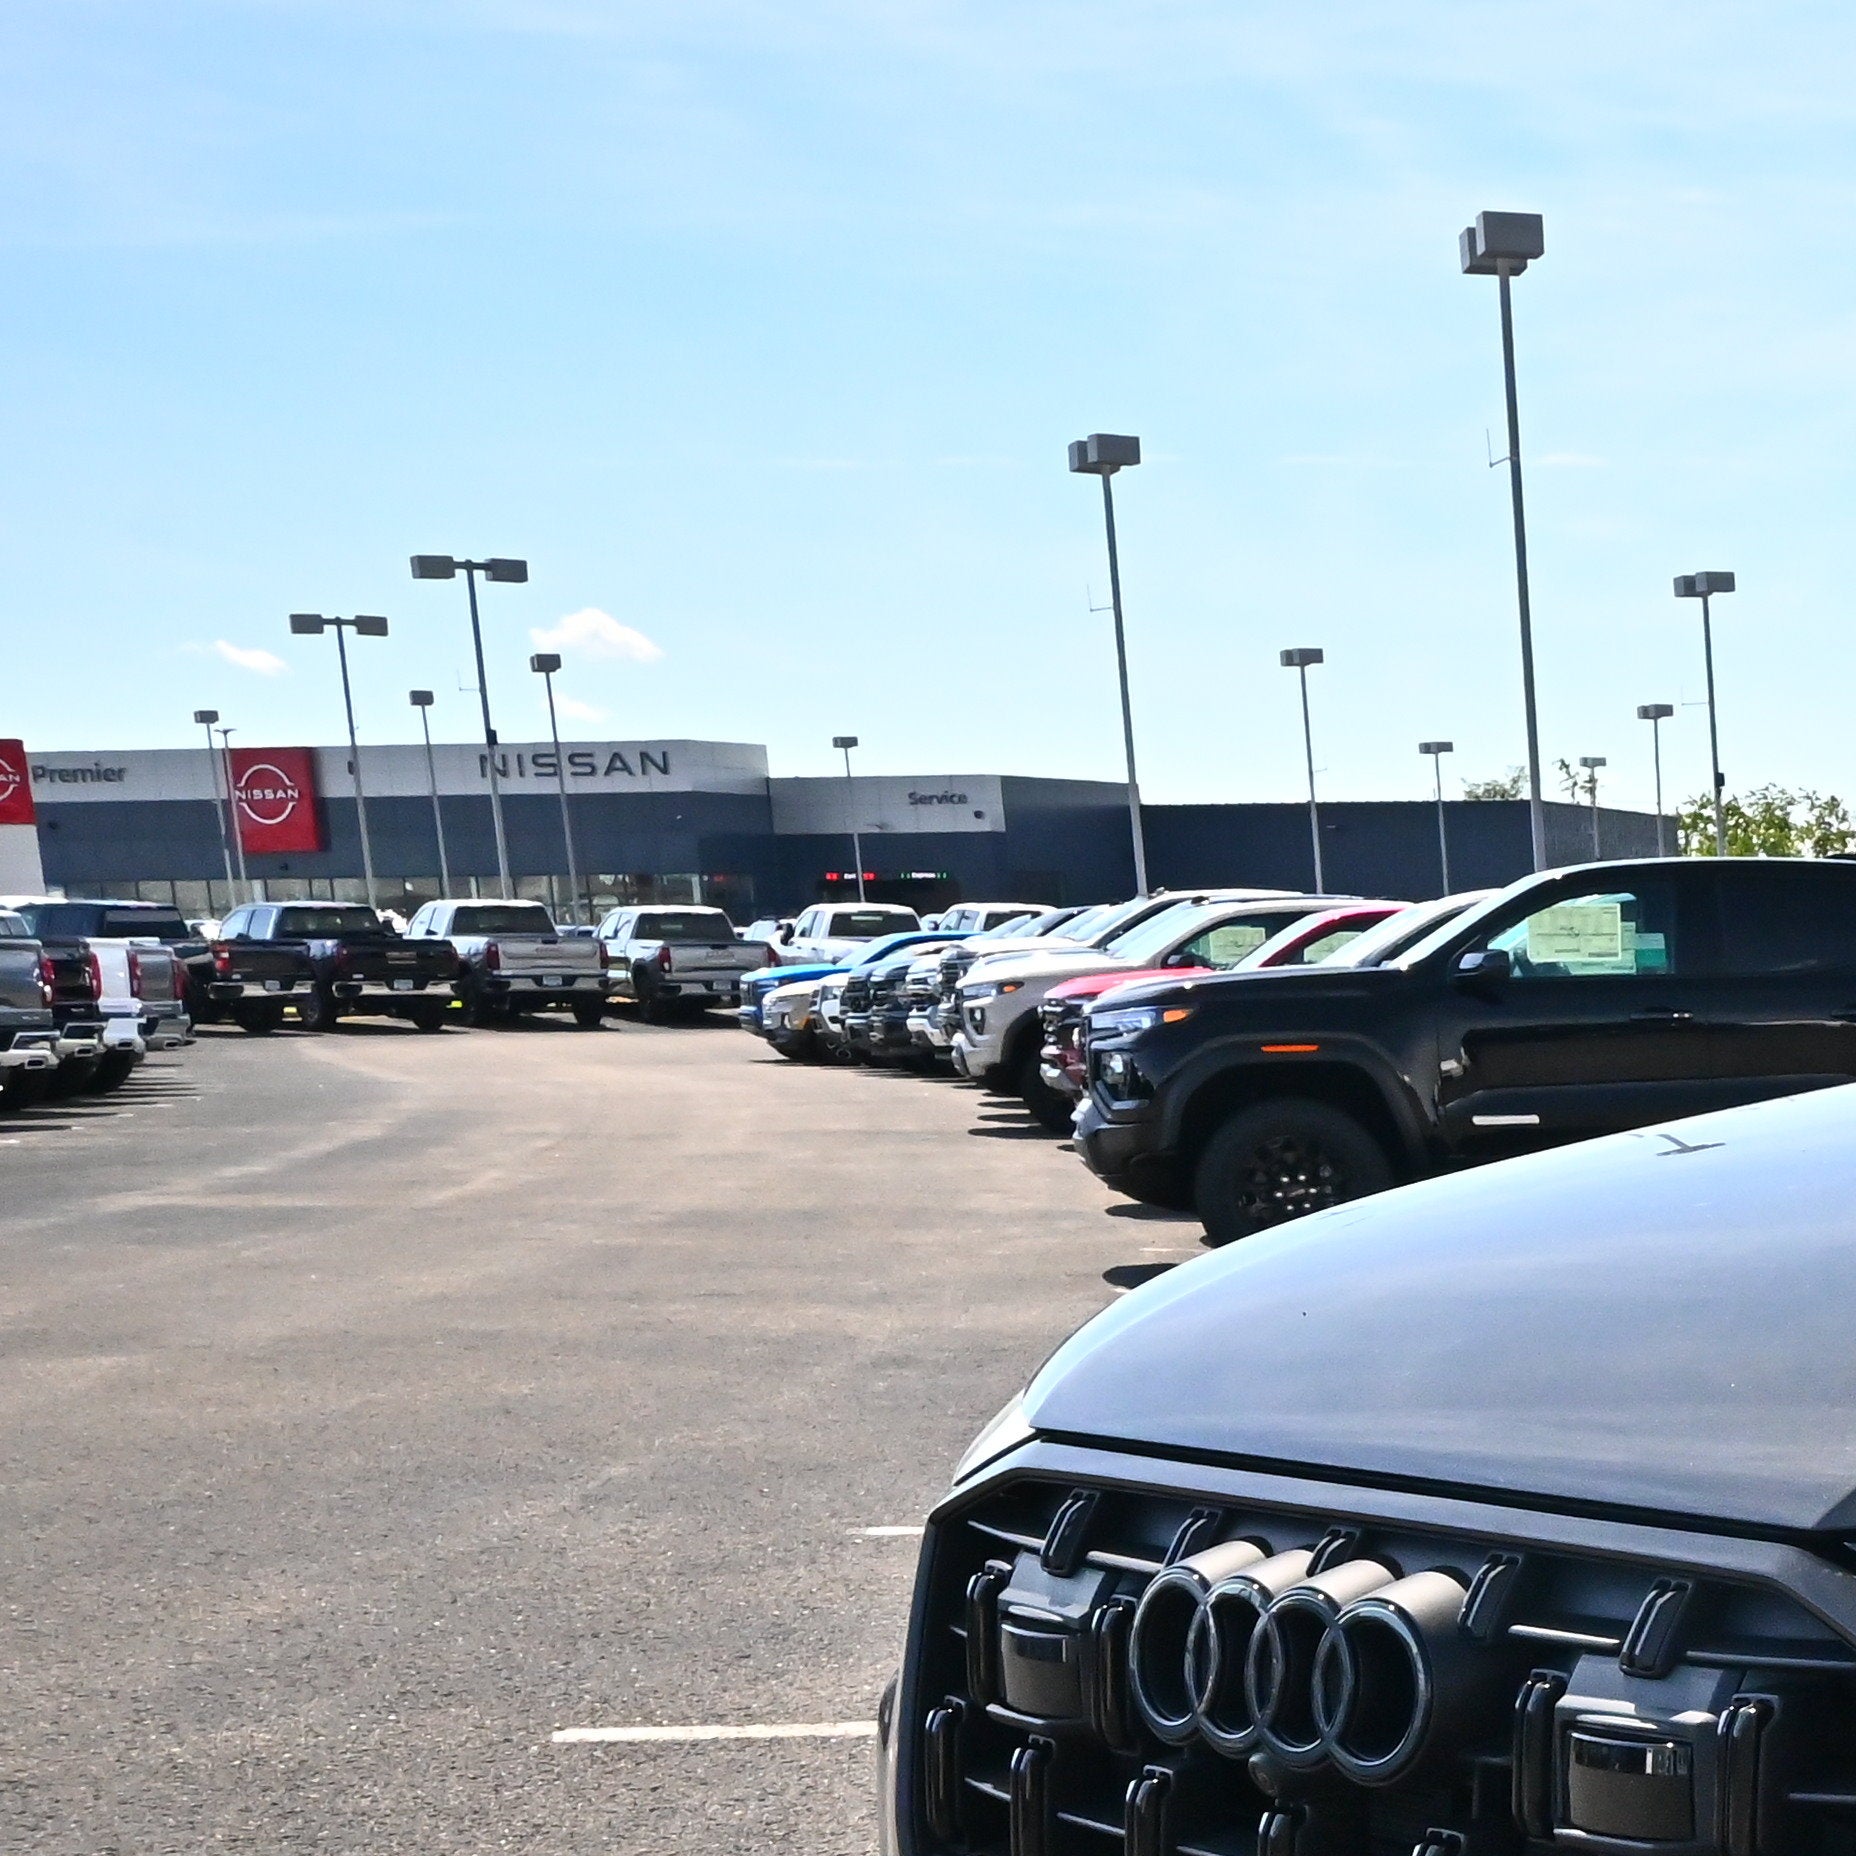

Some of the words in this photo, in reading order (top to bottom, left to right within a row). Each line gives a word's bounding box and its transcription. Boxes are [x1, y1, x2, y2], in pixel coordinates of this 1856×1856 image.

[31, 762, 127, 784] Premier
[479, 750, 671, 778] NISSAN
[234, 787, 299, 801] NISSAN
[907, 790, 968, 806] Service
